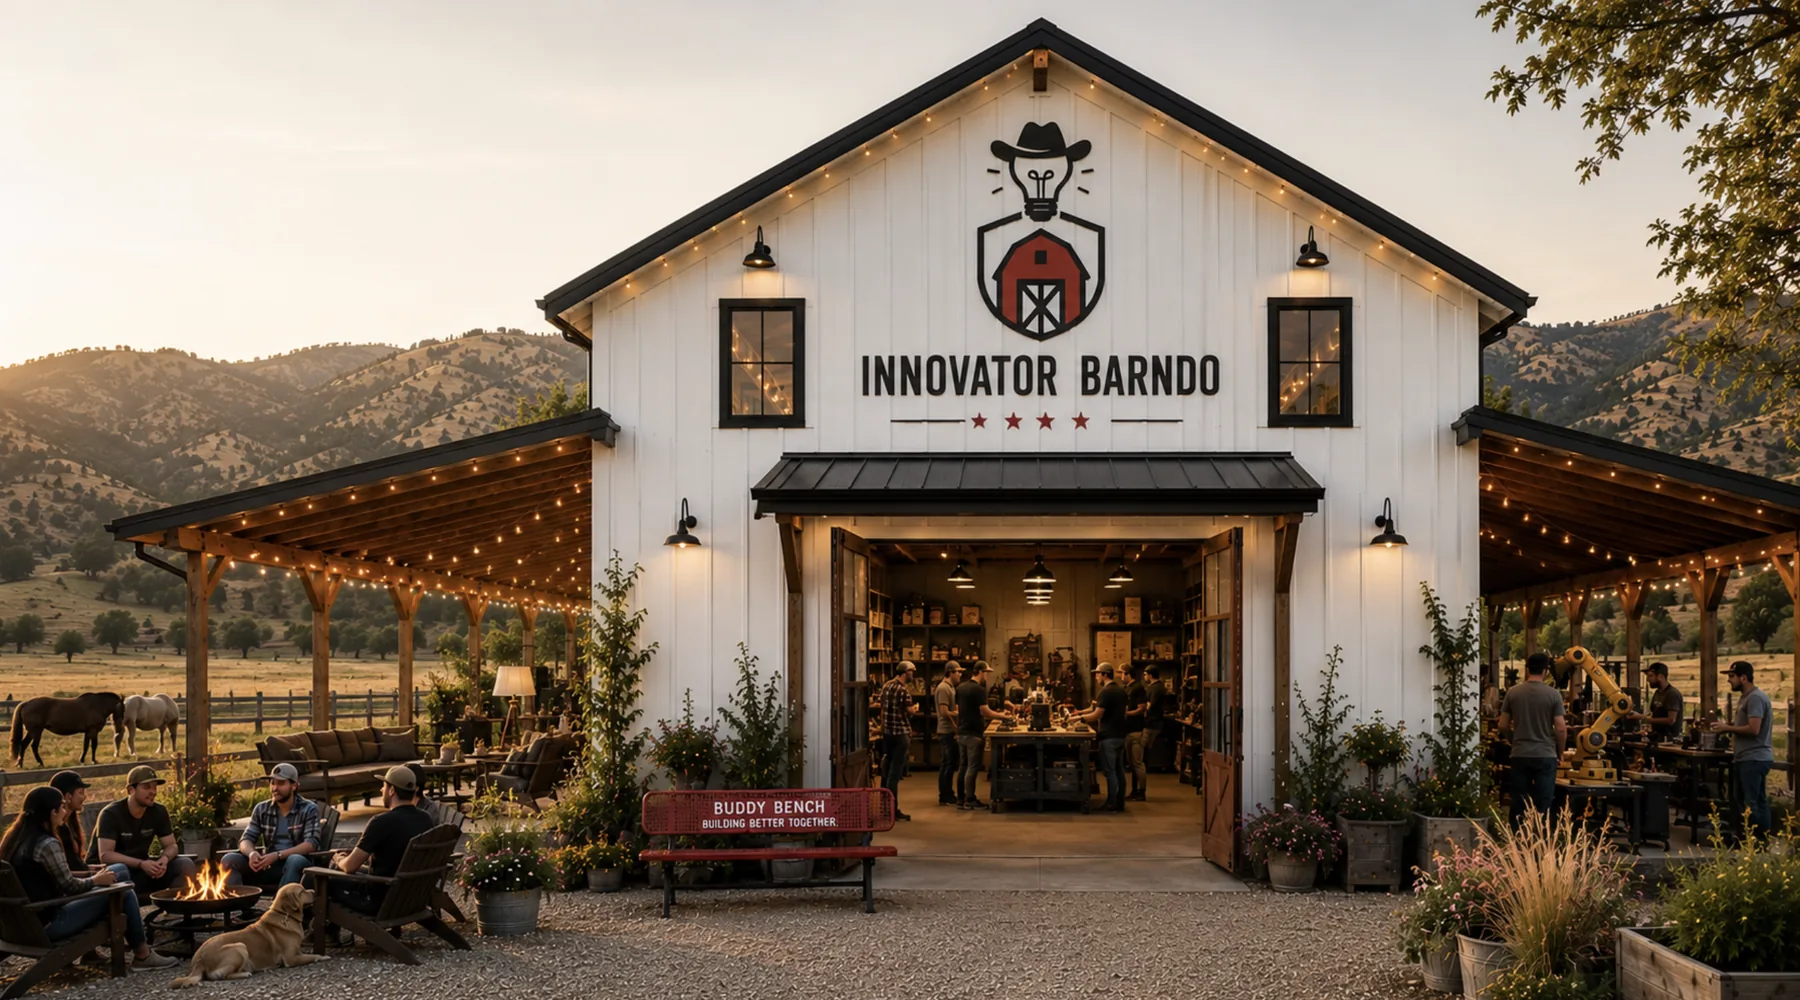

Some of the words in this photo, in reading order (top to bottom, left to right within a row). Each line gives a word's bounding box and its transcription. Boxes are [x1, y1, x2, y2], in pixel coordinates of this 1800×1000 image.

[862, 355, 1057, 397] INNOVATOR
[1081, 355, 1220, 397] BARNDO
[714, 801, 766, 815] BUDDY
[774, 800, 825, 814] BENCH
[702, 819, 746, 829] BUILDING
[749, 818, 785, 828] BETTER
